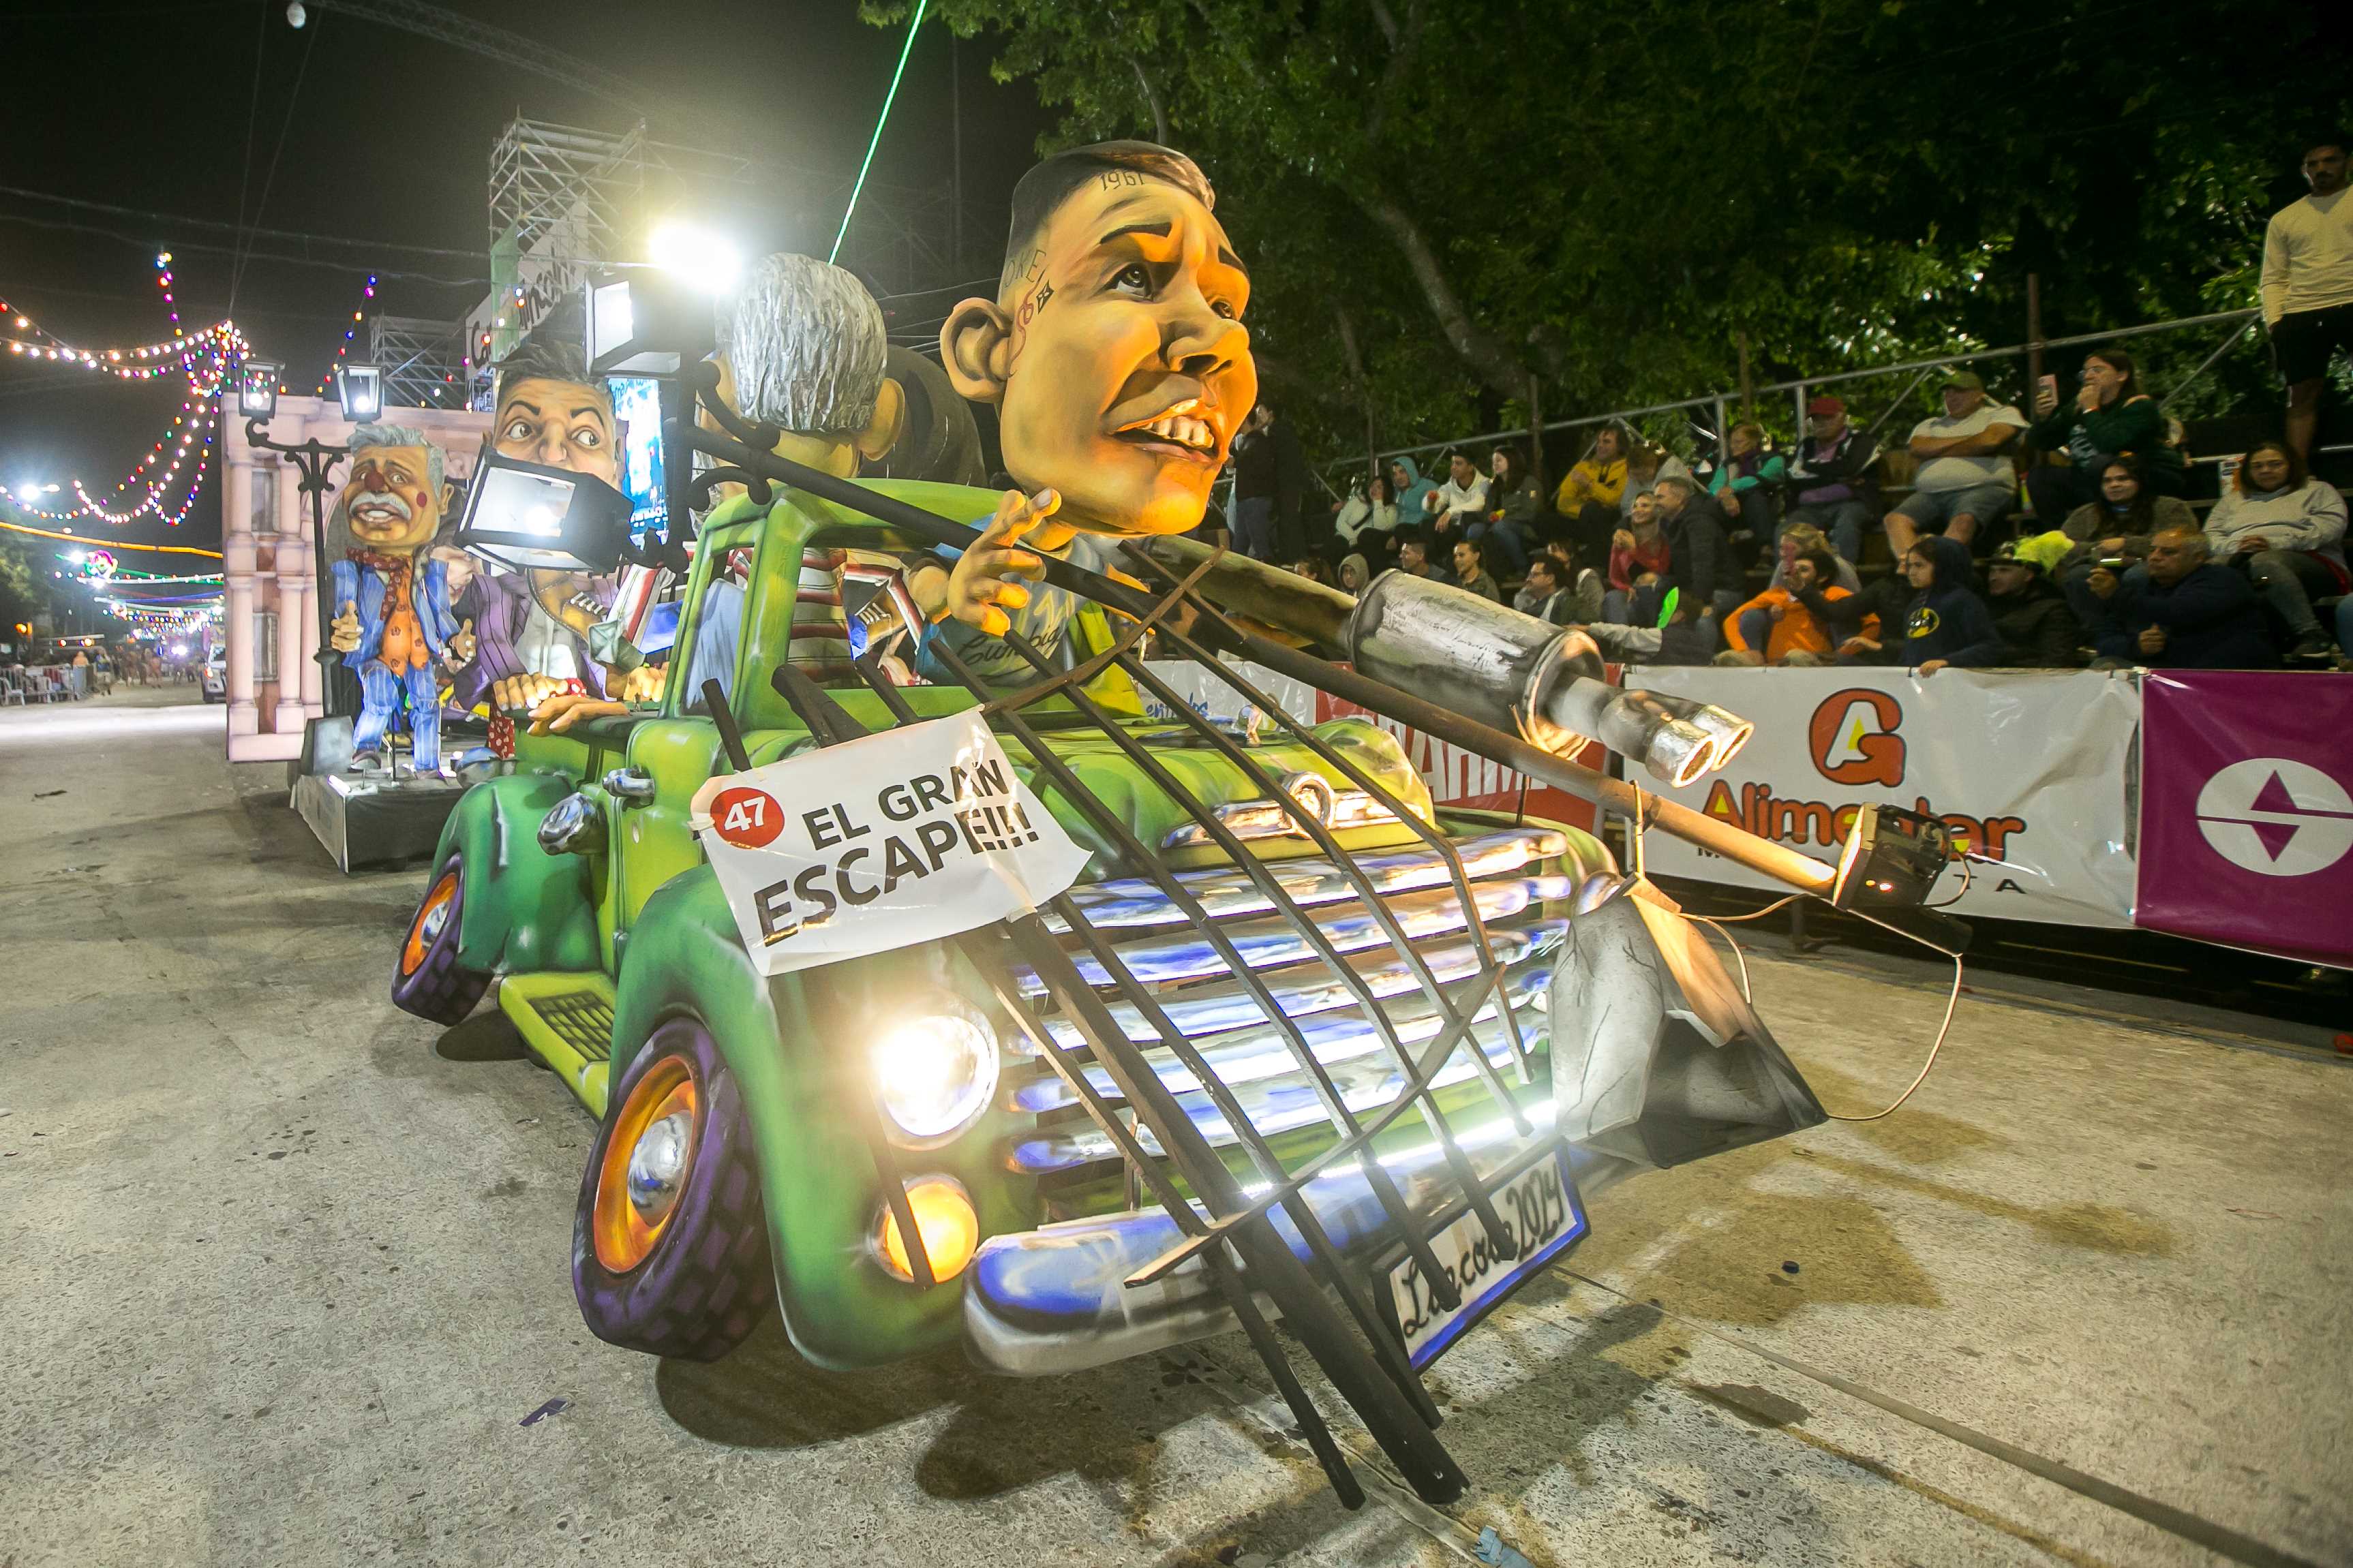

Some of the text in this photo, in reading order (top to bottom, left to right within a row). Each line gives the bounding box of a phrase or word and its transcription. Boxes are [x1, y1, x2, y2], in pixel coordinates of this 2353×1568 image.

[1100, 171, 1144, 191] 1961
[724, 795, 767, 831] 47
[802, 758, 1009, 850] EL GRAN
[1701, 779, 2027, 864] Alimetar
[753, 802, 1040, 947] ESCAPE!!!
